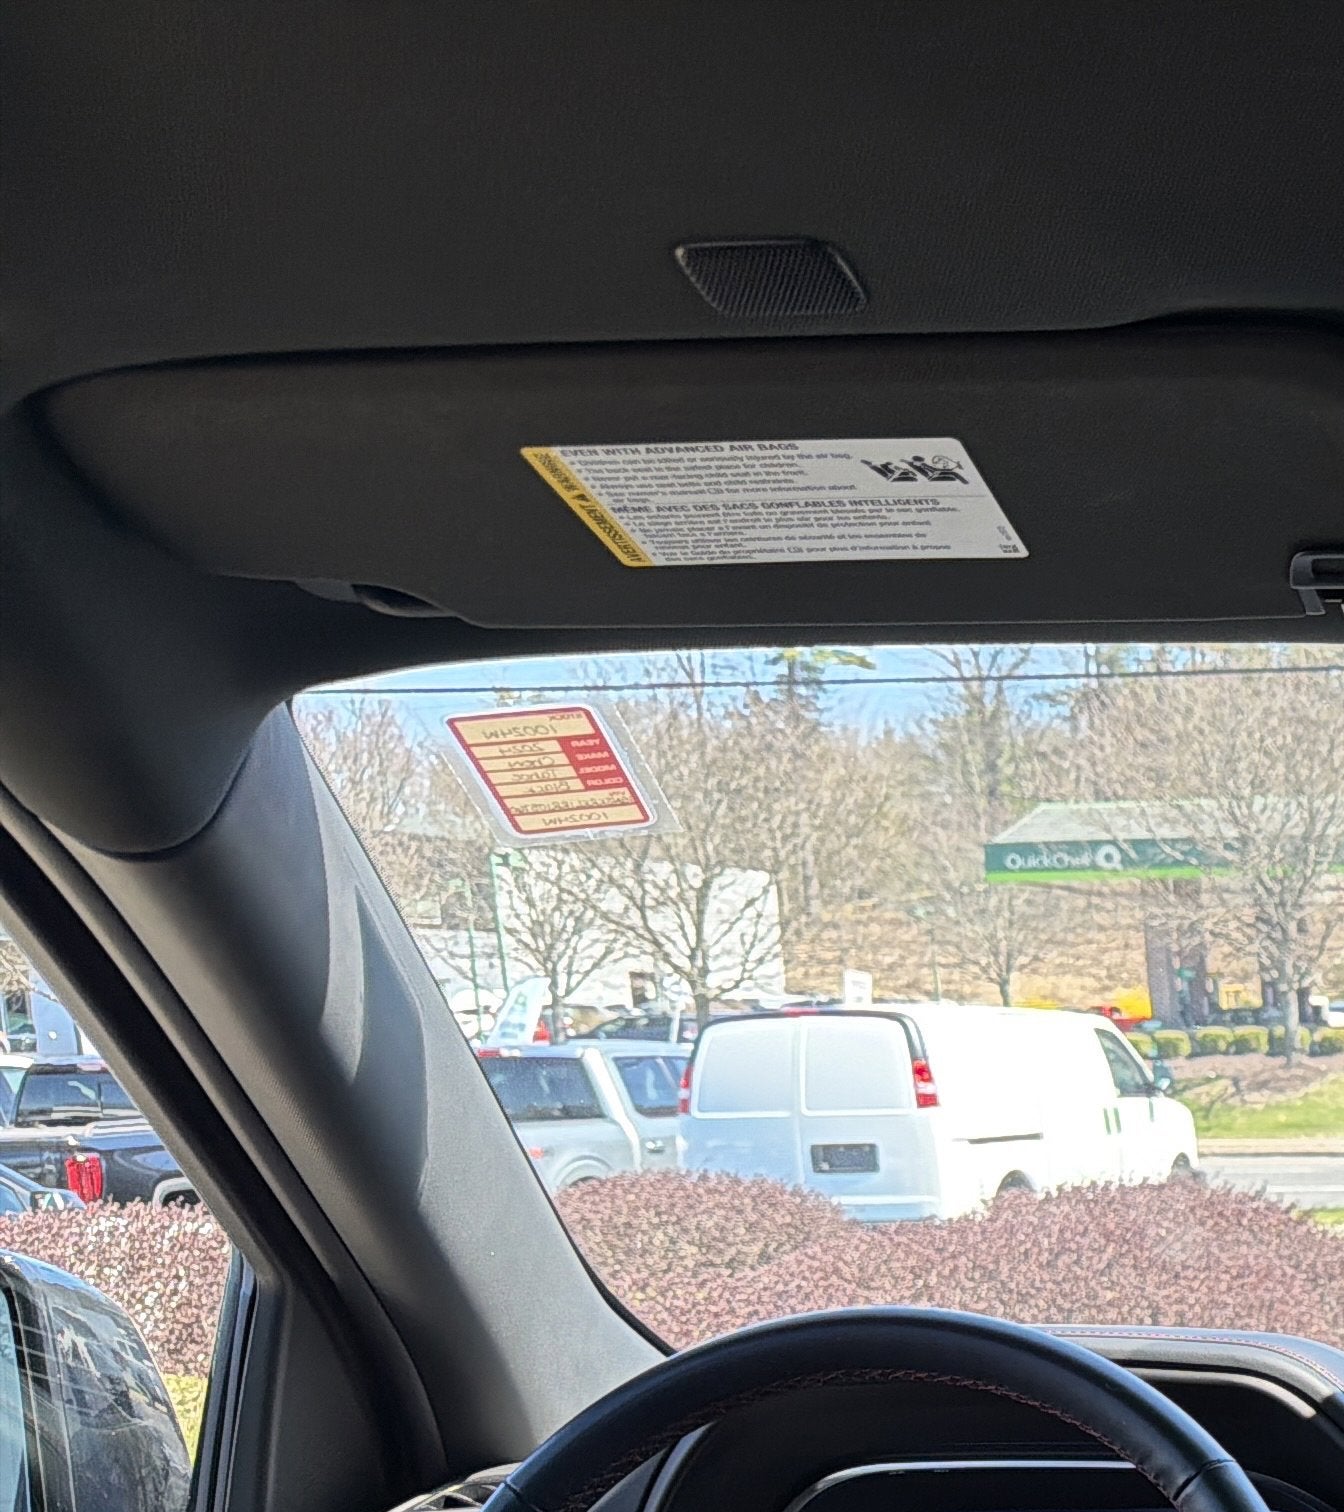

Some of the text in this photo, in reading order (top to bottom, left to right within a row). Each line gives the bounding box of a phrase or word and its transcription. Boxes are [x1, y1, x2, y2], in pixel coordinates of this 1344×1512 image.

[560, 443, 800, 458] EVEN WITH ADVANCED AIR BAGS
[657, 504, 690, 513] AVEC
[693, 503, 719, 511] DES
[848, 498, 941, 507] INTELLIGENTS
